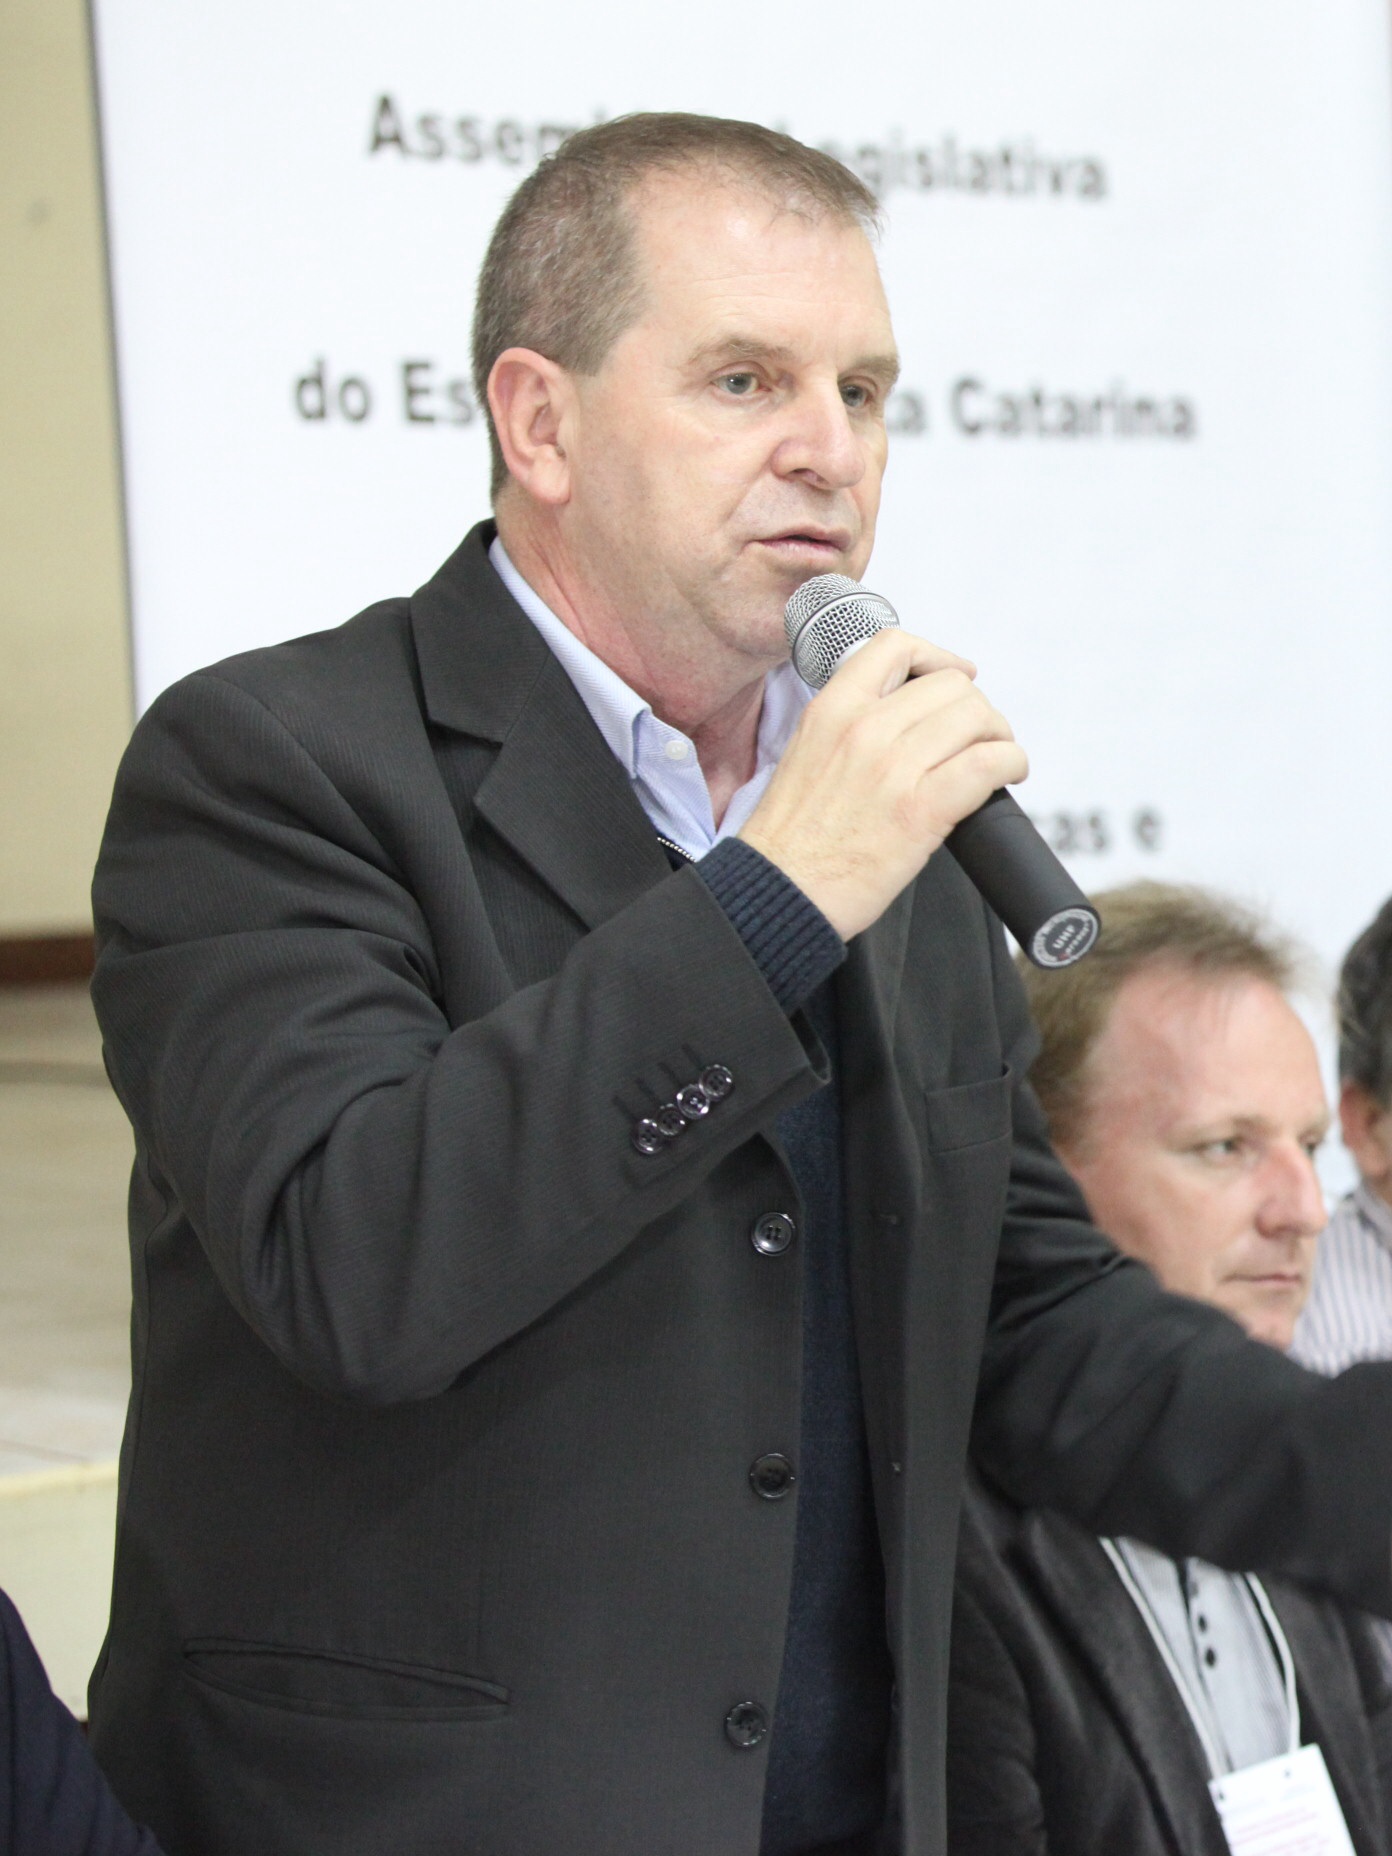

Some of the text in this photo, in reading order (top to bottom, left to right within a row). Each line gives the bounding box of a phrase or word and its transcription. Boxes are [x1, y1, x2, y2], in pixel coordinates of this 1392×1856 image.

[296, 358, 370, 422] do
[402, 360, 476, 426] Es
[950, 378, 1197, 440] Catarina
[1133, 806, 1163, 854] e
